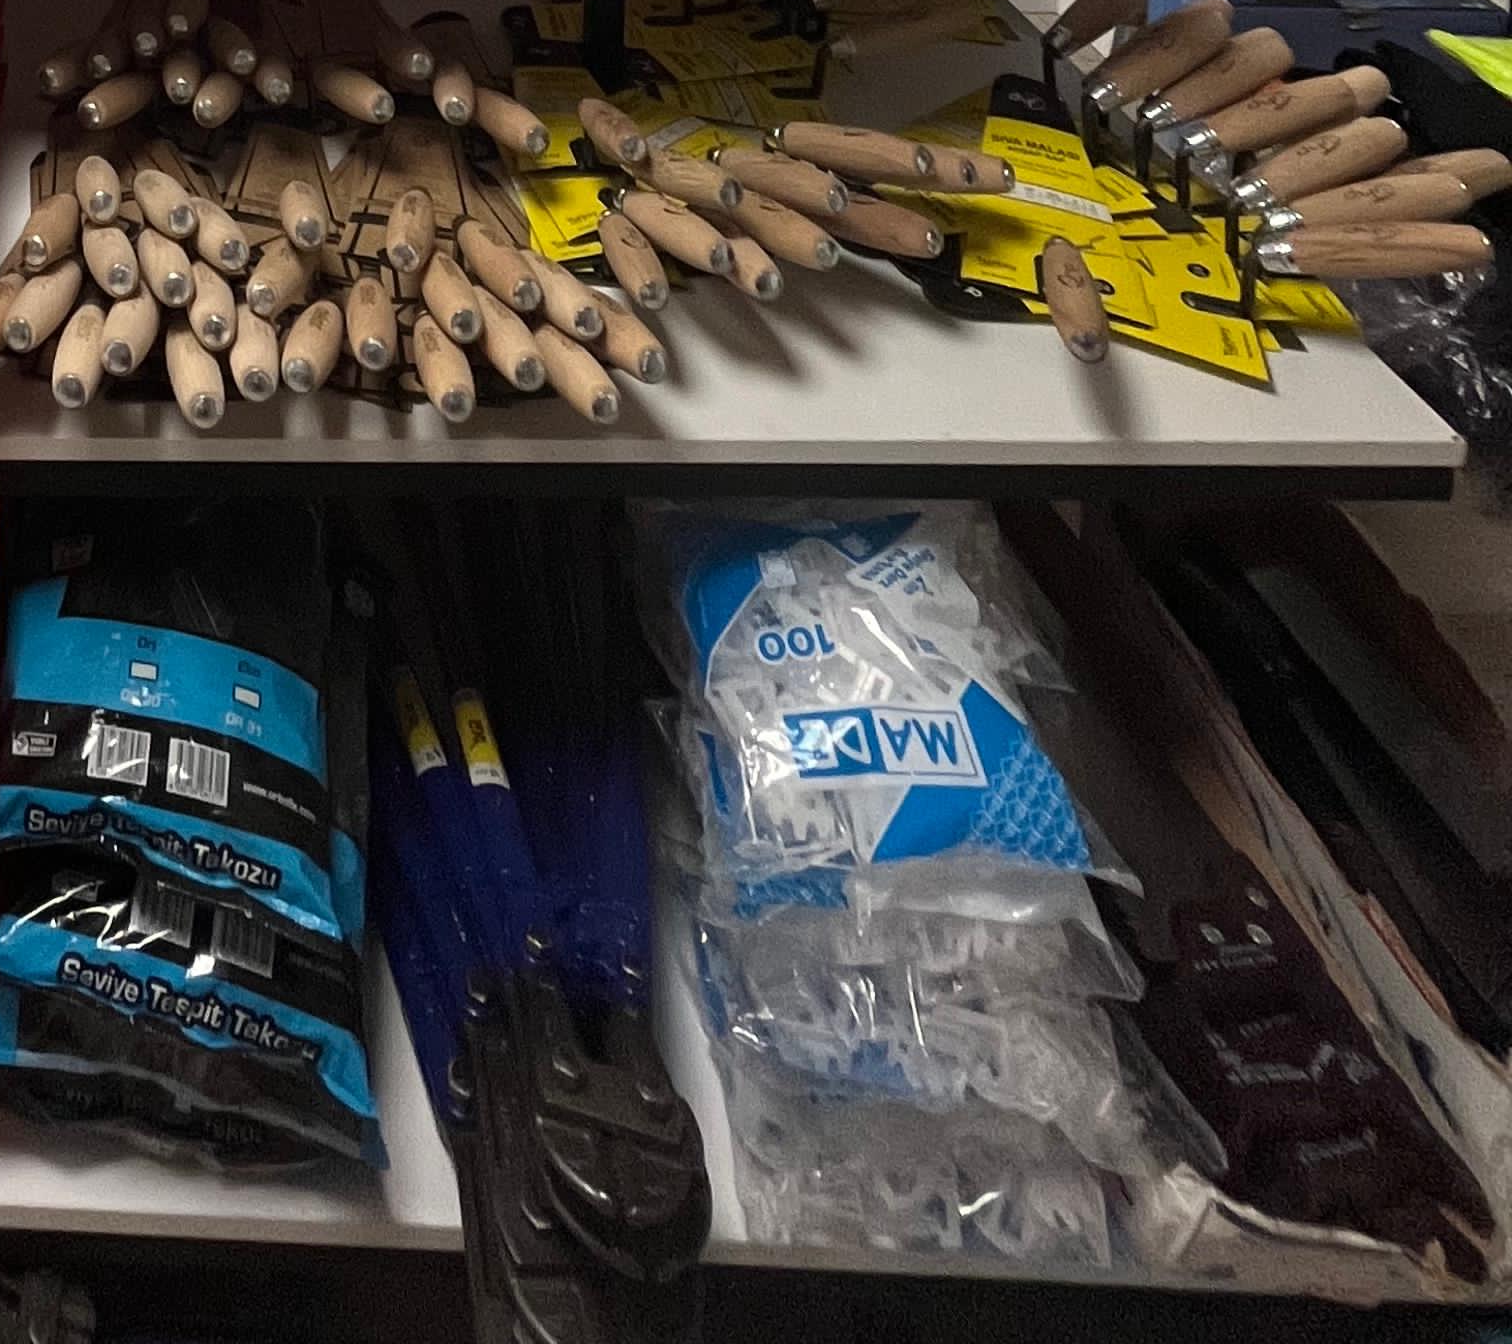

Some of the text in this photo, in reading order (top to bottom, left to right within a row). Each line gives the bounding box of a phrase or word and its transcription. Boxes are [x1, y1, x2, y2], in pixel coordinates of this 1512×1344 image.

[757, 622, 836, 663] 100
[61, 957, 322, 1062] Seviye Tespit Takou
